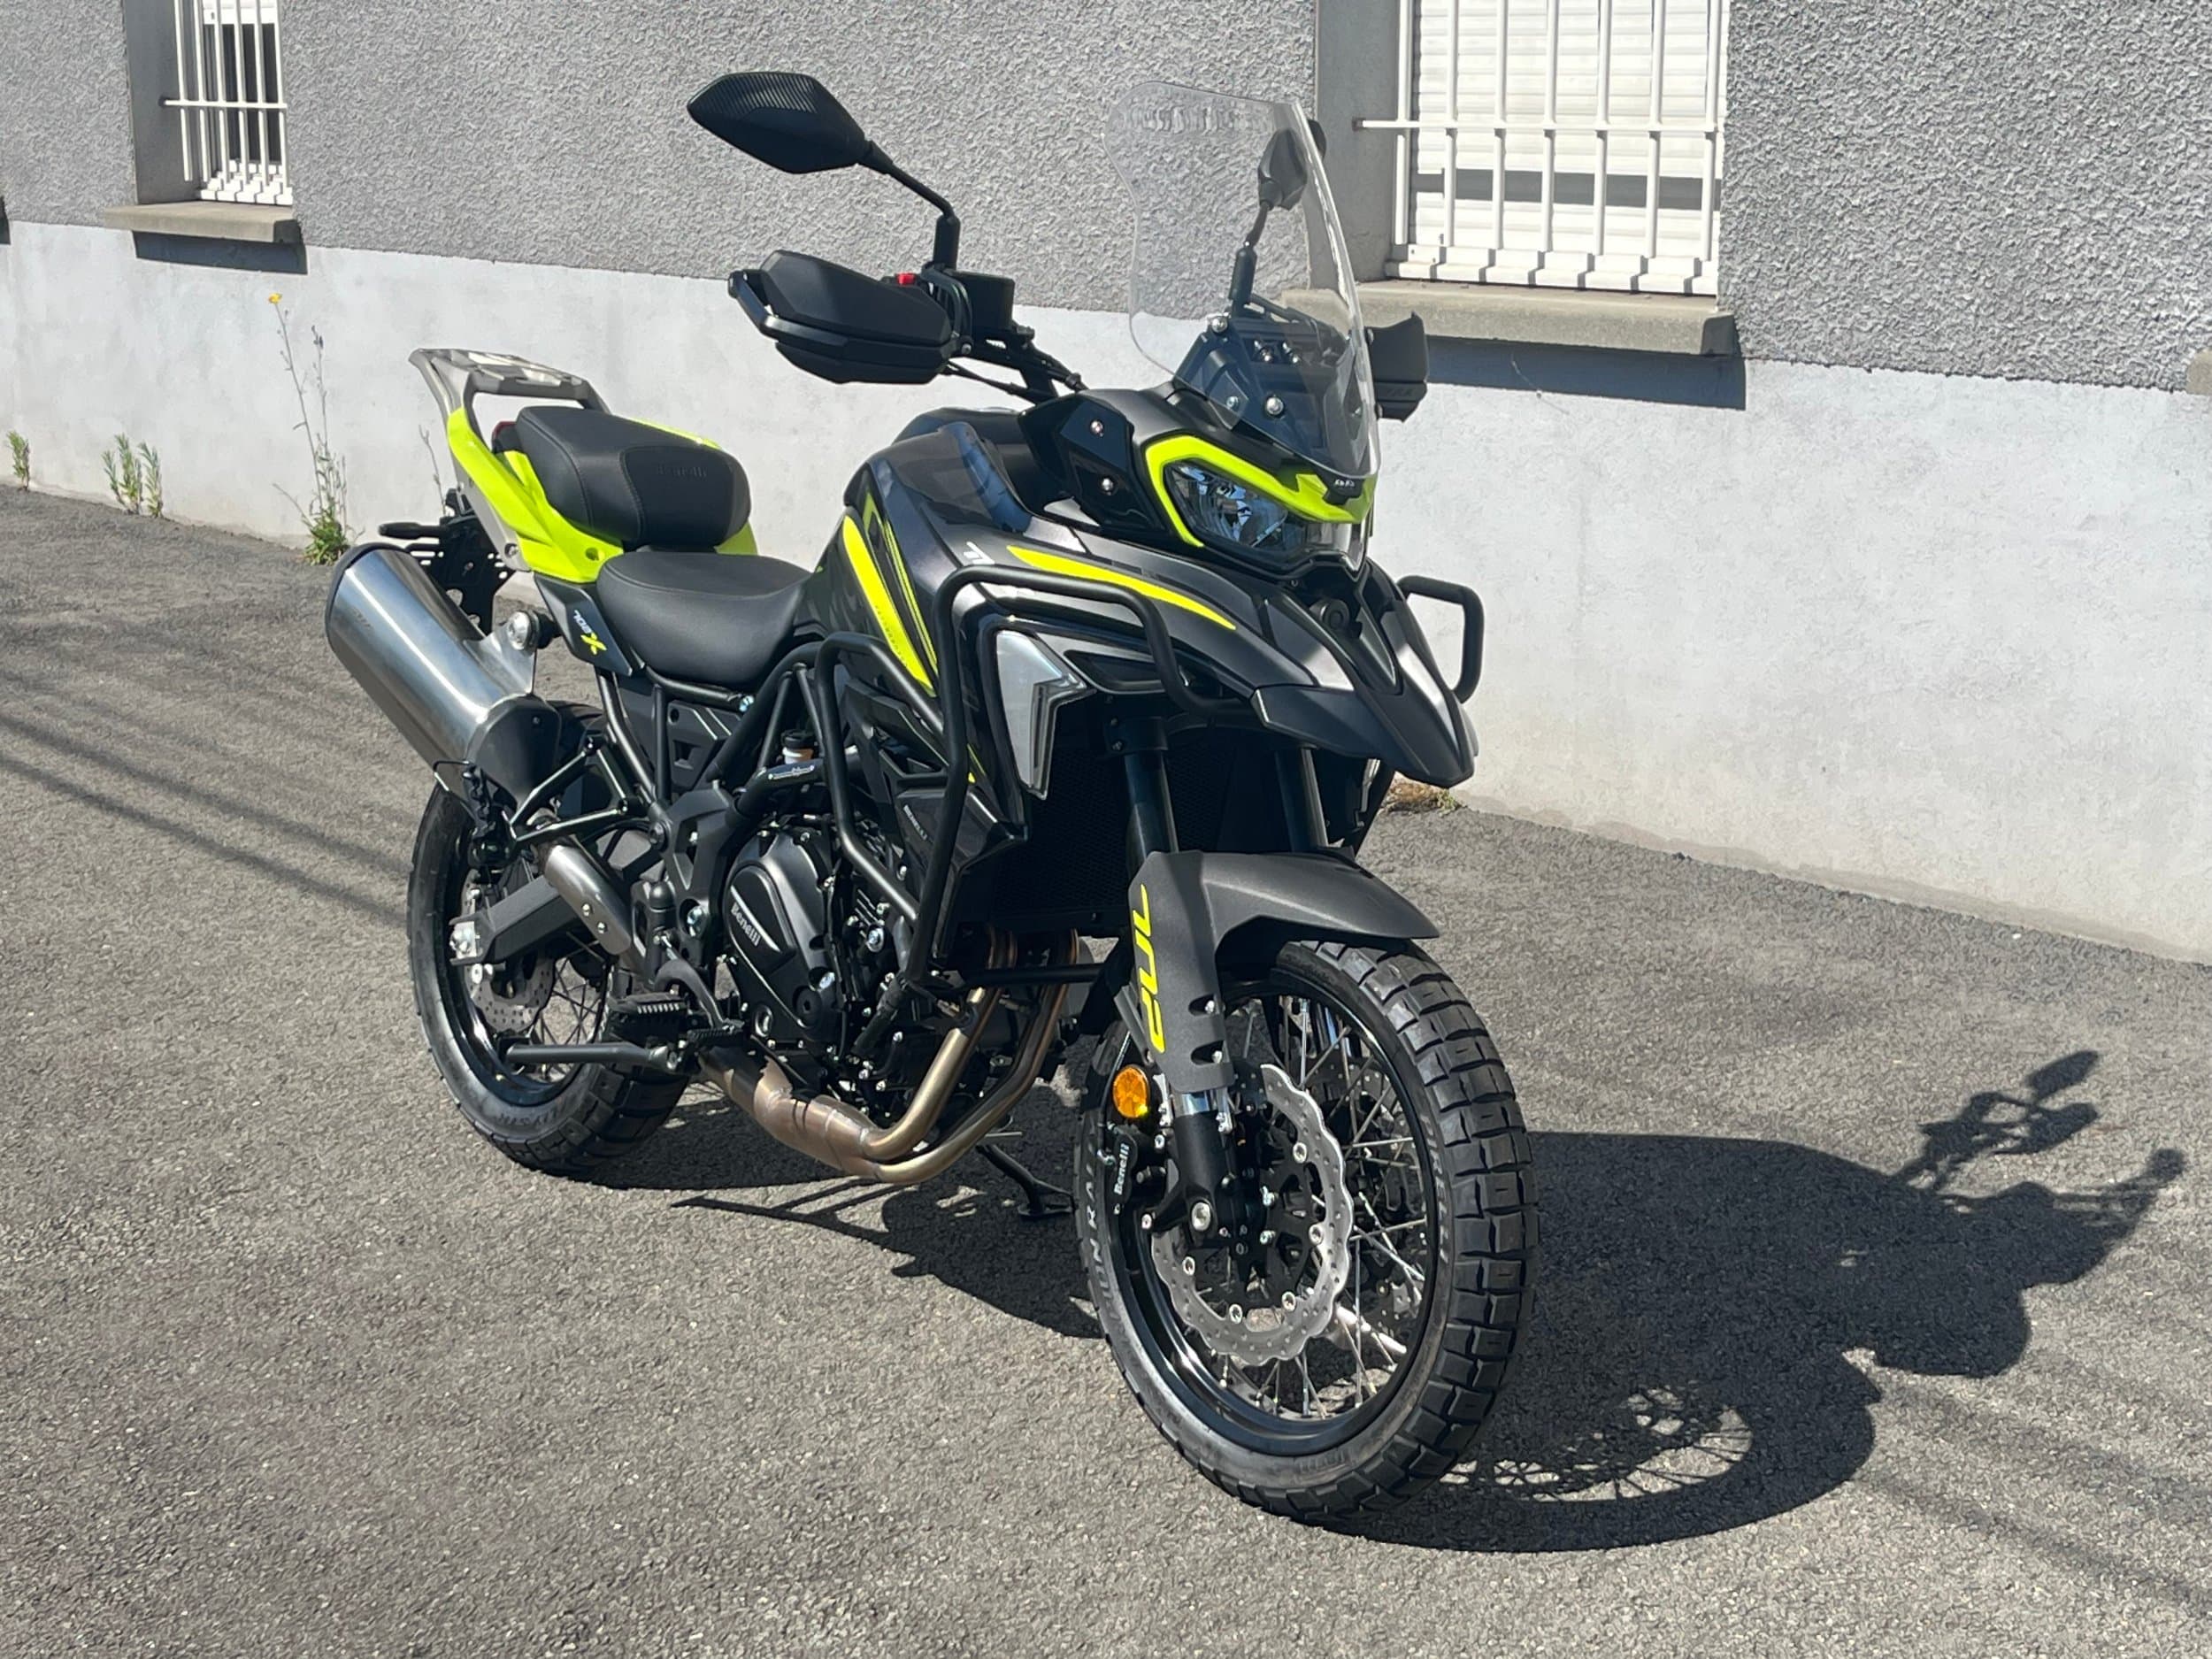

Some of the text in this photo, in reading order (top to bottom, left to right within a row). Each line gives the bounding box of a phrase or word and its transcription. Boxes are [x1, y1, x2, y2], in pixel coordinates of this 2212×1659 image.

[730, 902, 762, 947] Benelli
[1113, 1142, 1130, 1195] Benelli
[1420, 1115, 1449, 1263] PIRELLI
